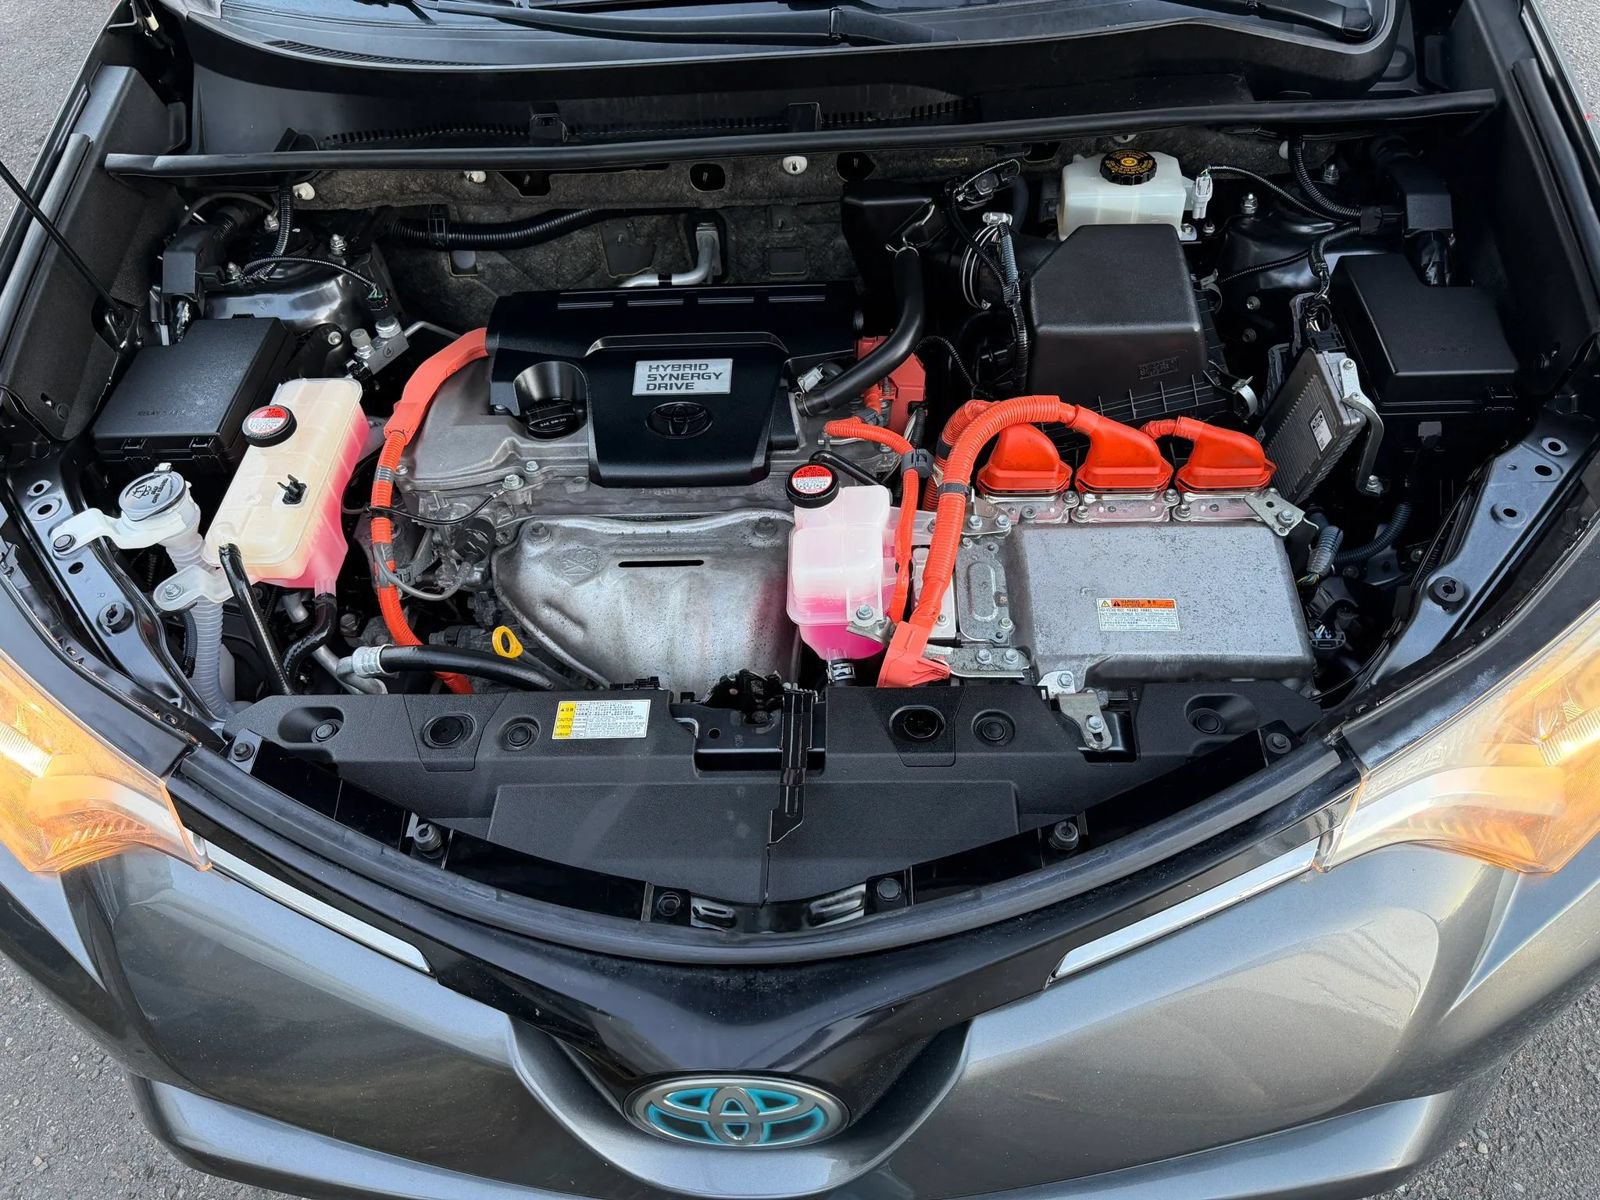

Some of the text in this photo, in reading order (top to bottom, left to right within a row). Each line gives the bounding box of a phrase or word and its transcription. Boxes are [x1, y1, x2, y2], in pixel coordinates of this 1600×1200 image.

[648, 363, 709, 372] HYBRID
[647, 372, 723, 382] SYNERGY
[646, 382, 695, 391] DRIVE
